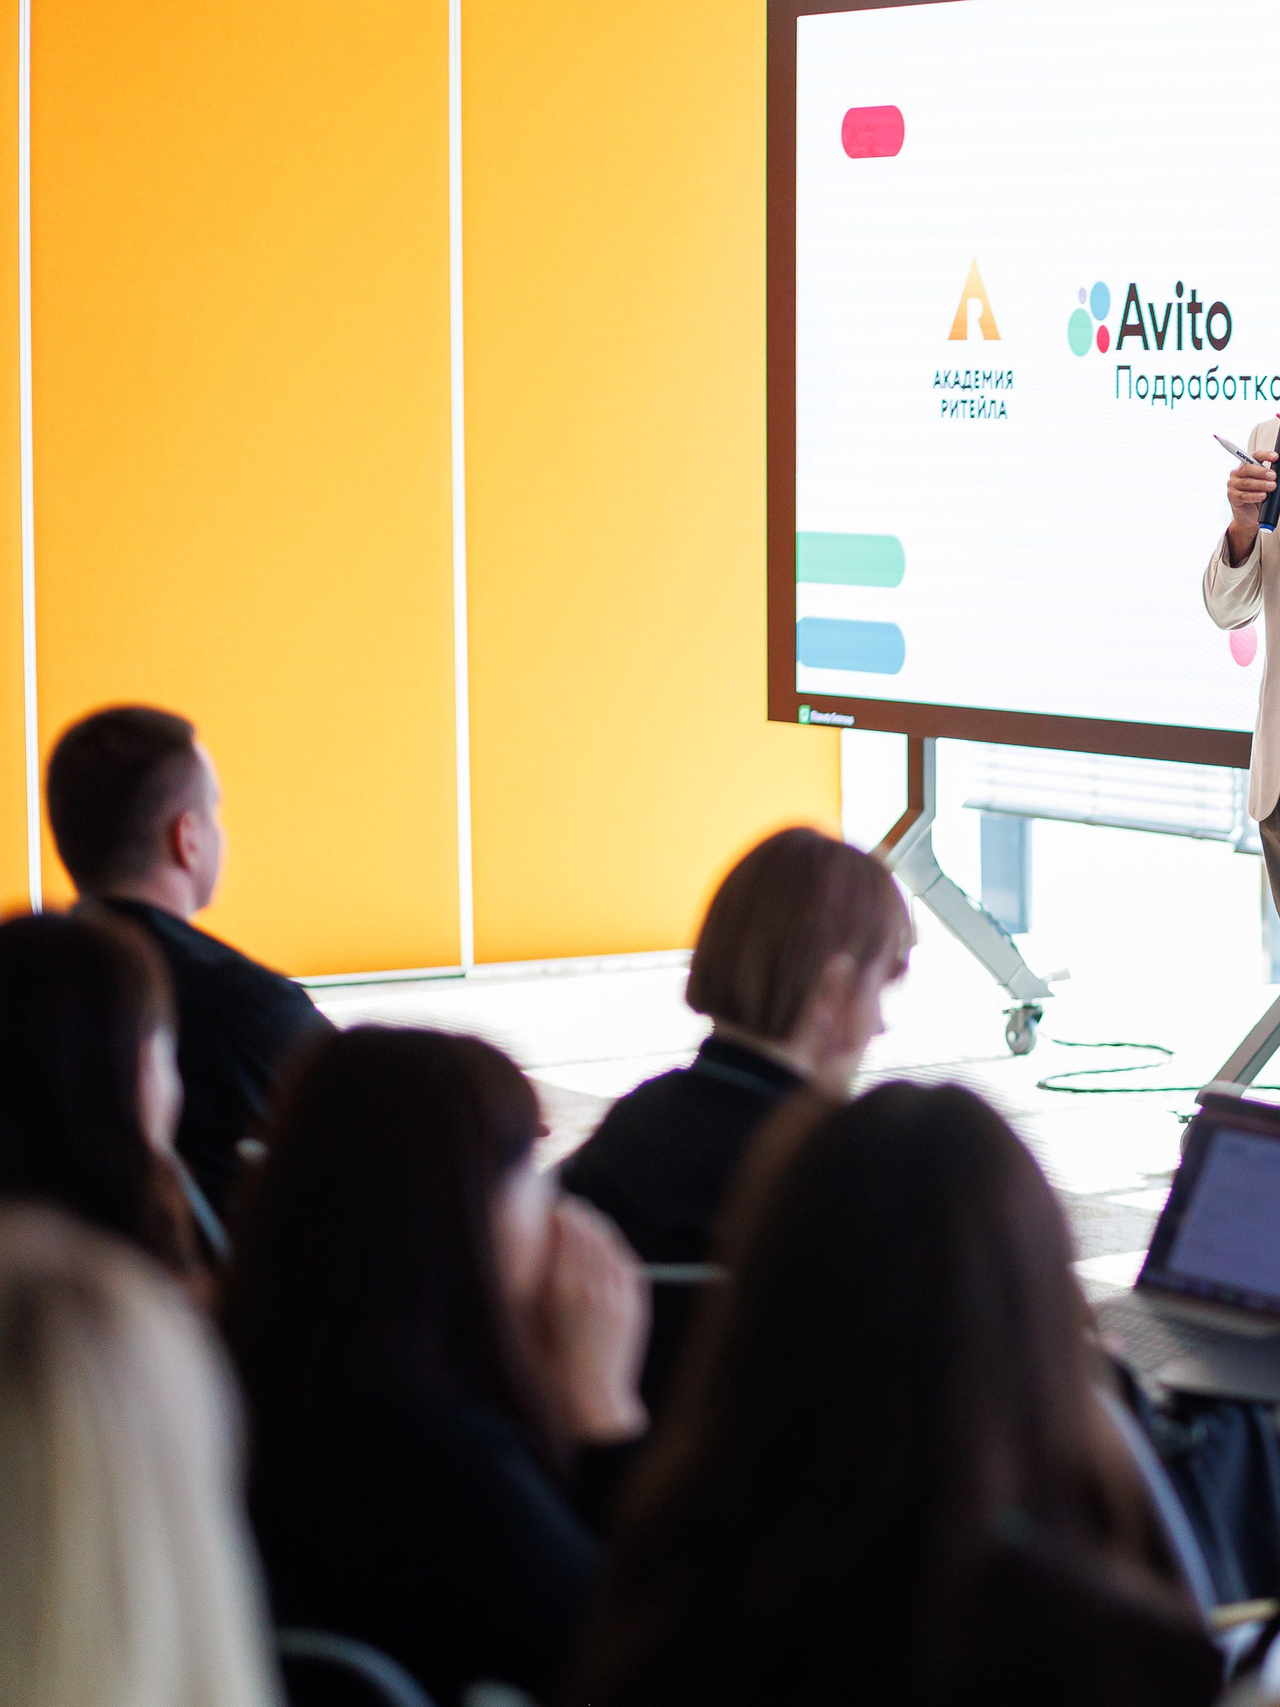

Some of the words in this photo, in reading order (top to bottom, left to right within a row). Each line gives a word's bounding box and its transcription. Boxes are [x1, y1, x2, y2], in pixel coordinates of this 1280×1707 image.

[1116, 280, 1232, 351] Avito
[933, 369, 1014, 391] АКАДЕМИЯ
[941, 394, 1009, 419] РИТЕЙЛА
